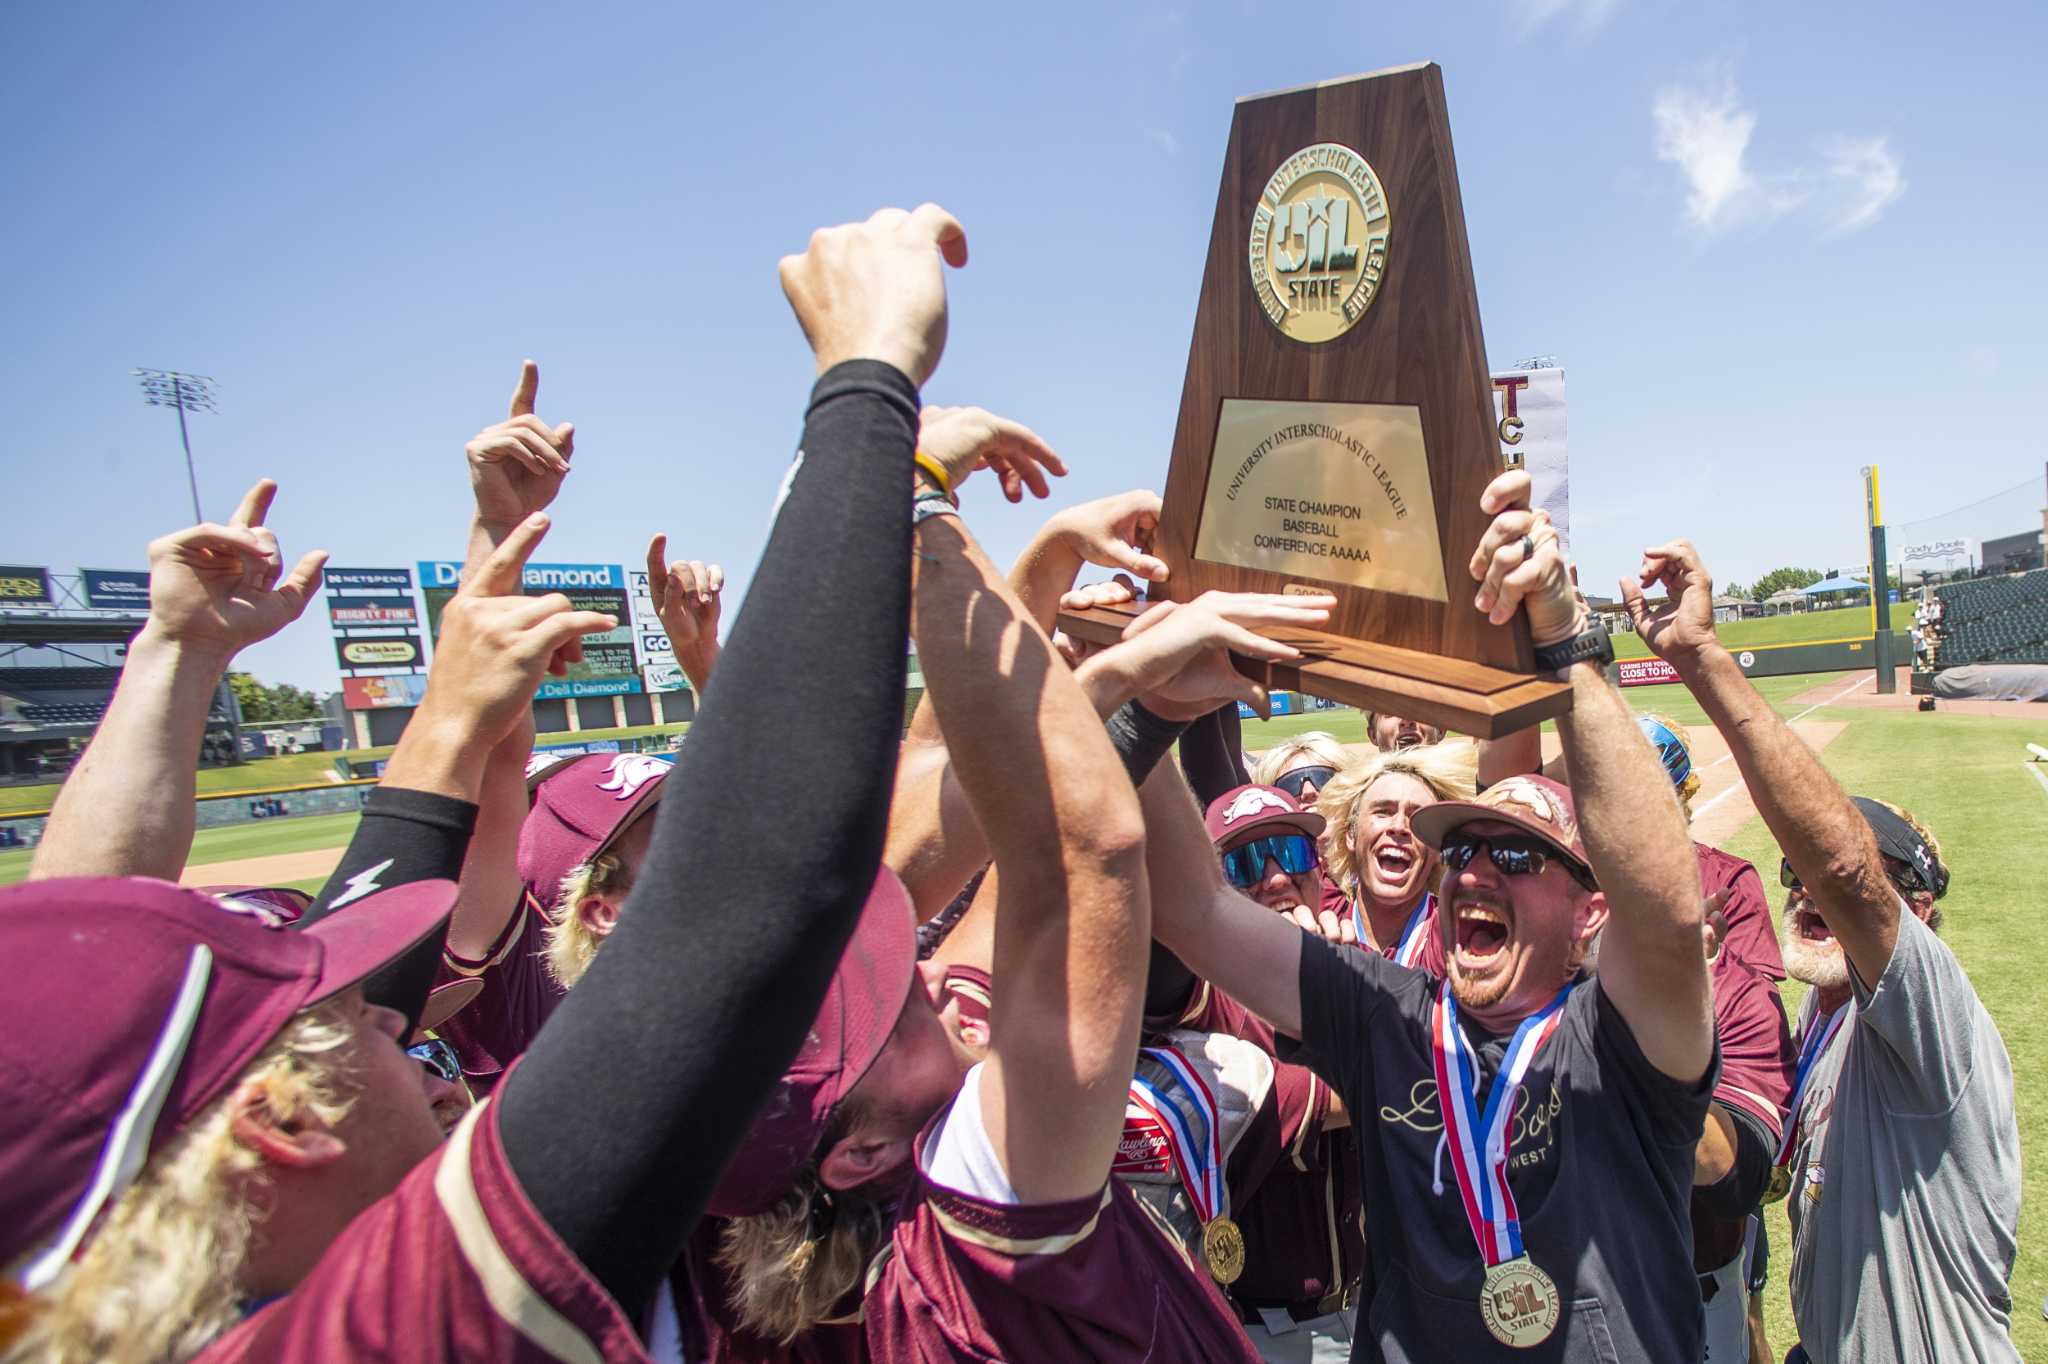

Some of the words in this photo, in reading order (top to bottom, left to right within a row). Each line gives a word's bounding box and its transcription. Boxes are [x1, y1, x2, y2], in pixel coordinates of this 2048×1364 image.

[1251, 212, 1288, 324] UNIVERSITY
[1344, 236, 1385, 320] LEAGUE
[1288, 277, 1341, 298] STATE
[1226, 436, 1273, 501] UNIVERSITY
[1274, 423, 1376, 468] INTERSCHOLASTIC
[1372, 463, 1408, 520] LEAGUE
[1264, 497, 1296, 513] STATE
[1298, 500, 1361, 520] CHAMPION
[1283, 519, 1339, 538] BASEBALL
[1254, 534, 1328, 557] CONFERENCE
[1329, 545, 1371, 562] AAAAA
[1904, 544, 1932, 554] Cody
[343, 575, 407, 584] NETSPEND
[384, 607, 414, 619] FINE
[1620, 668, 1647, 679] CLOSE
[1647, 667, 1660, 677] TO
[1641, 661, 1653, 669] FOR
[544, 684, 571, 697] Dell
[573, 681, 630, 695] Diamond
[1510, 1316, 1540, 1331] STATE
